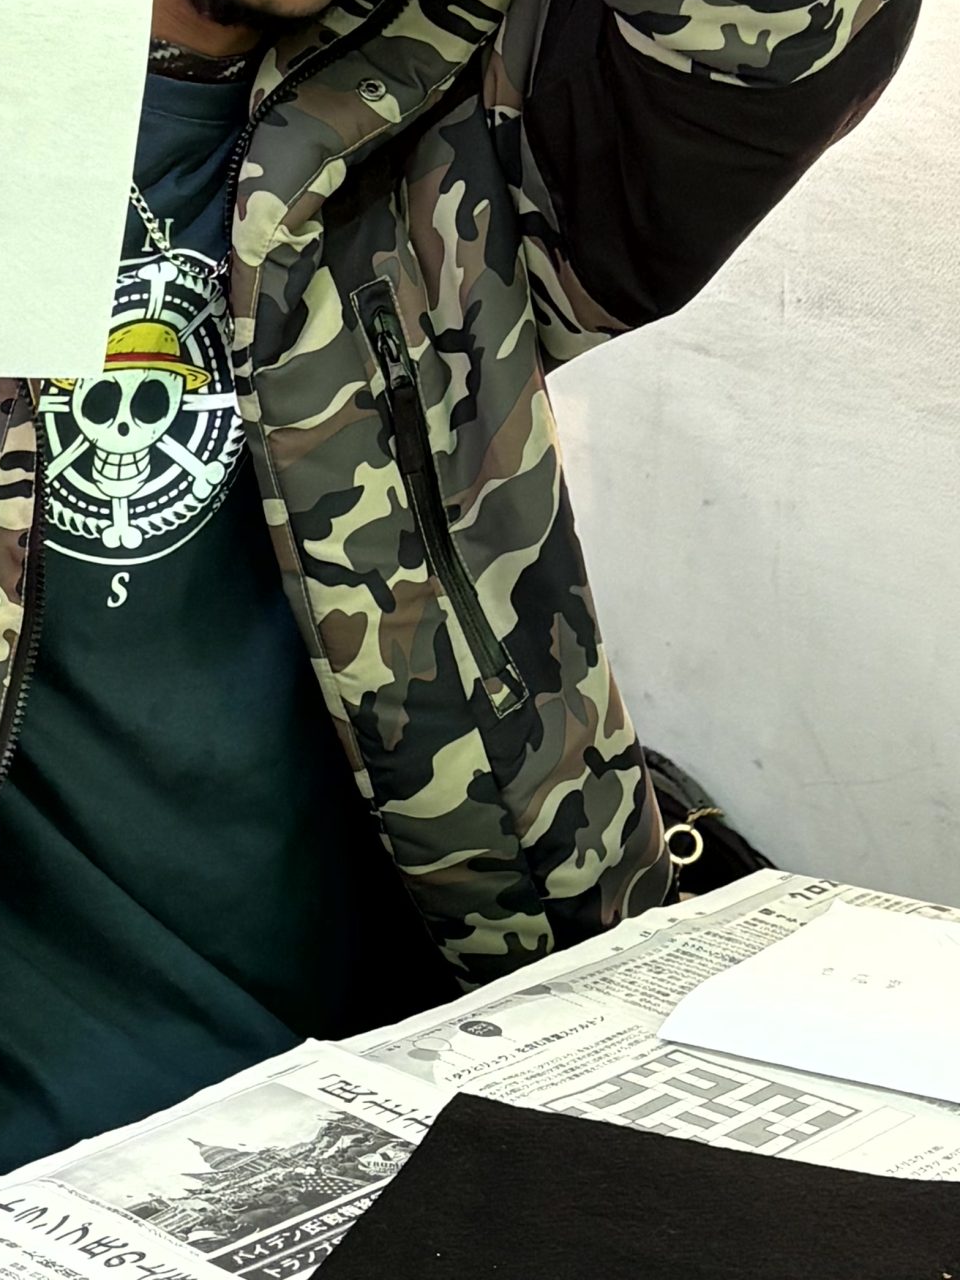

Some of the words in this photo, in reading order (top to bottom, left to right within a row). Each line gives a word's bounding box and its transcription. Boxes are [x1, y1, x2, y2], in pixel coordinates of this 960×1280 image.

[106, 572, 129, 608] S
[233, 1187, 384, 1265] バイデン氏政権
